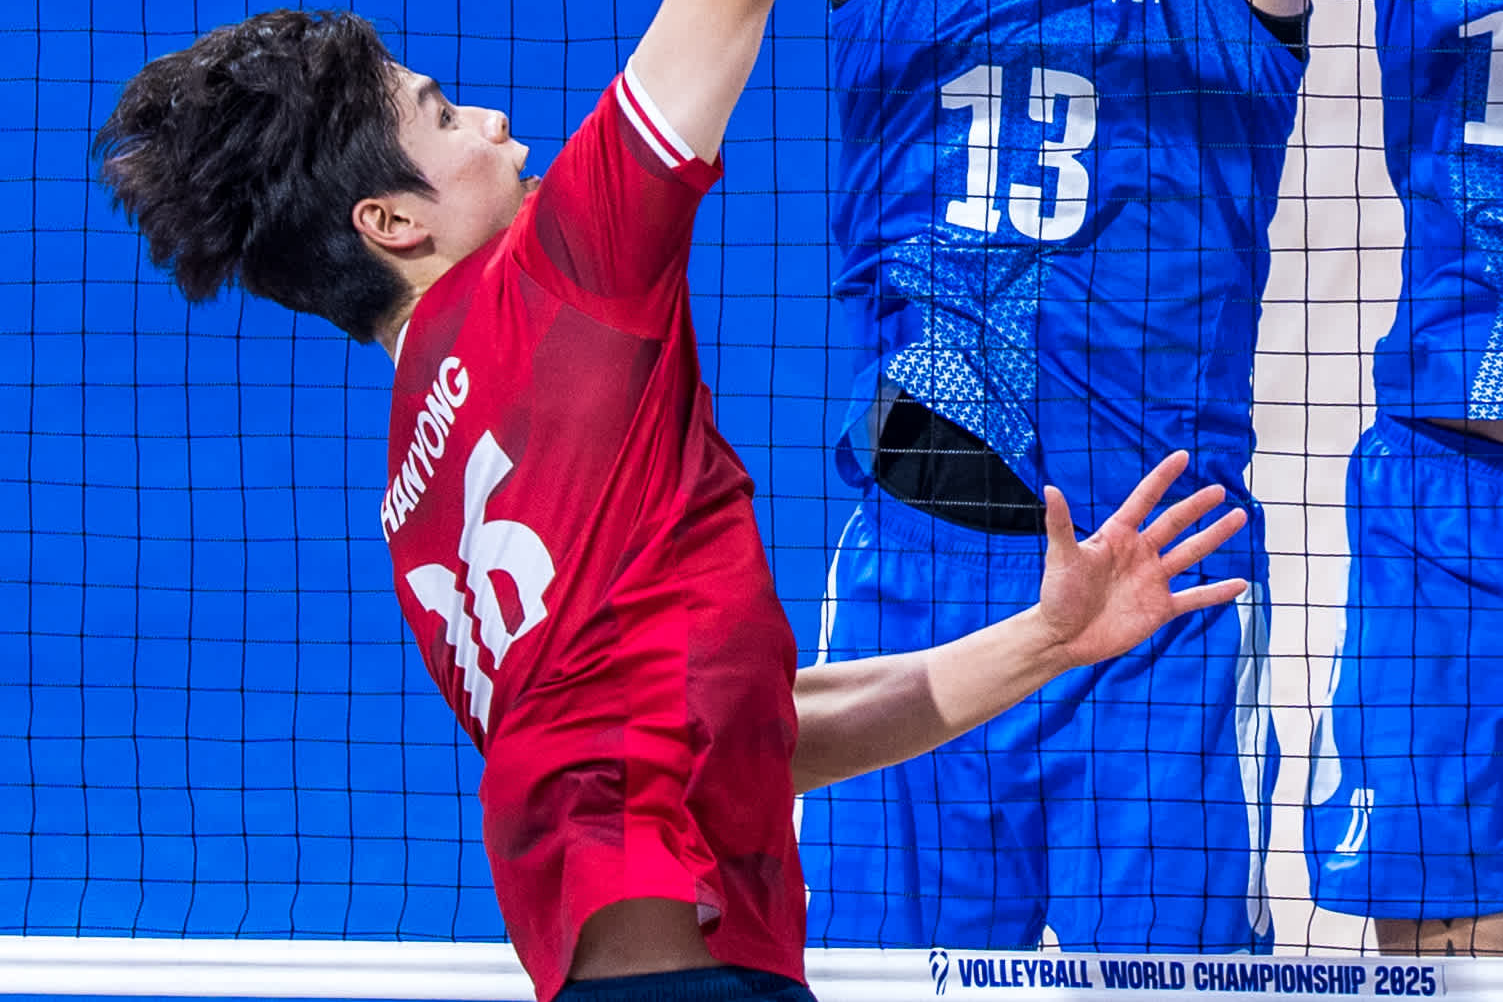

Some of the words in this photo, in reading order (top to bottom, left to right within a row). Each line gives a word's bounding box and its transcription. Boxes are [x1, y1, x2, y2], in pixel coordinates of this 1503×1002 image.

[940, 64, 1099, 242] 13
[381, 356, 470, 542] HANYONG
[405, 430, 556, 735] 16
[958, 958, 1092, 990] VOLLEYBALL
[1100, 960, 1185, 992] WORLD
[1193, 962, 1366, 996] CHAMPIONSHIP
[1374, 965, 1436, 996] 2025
